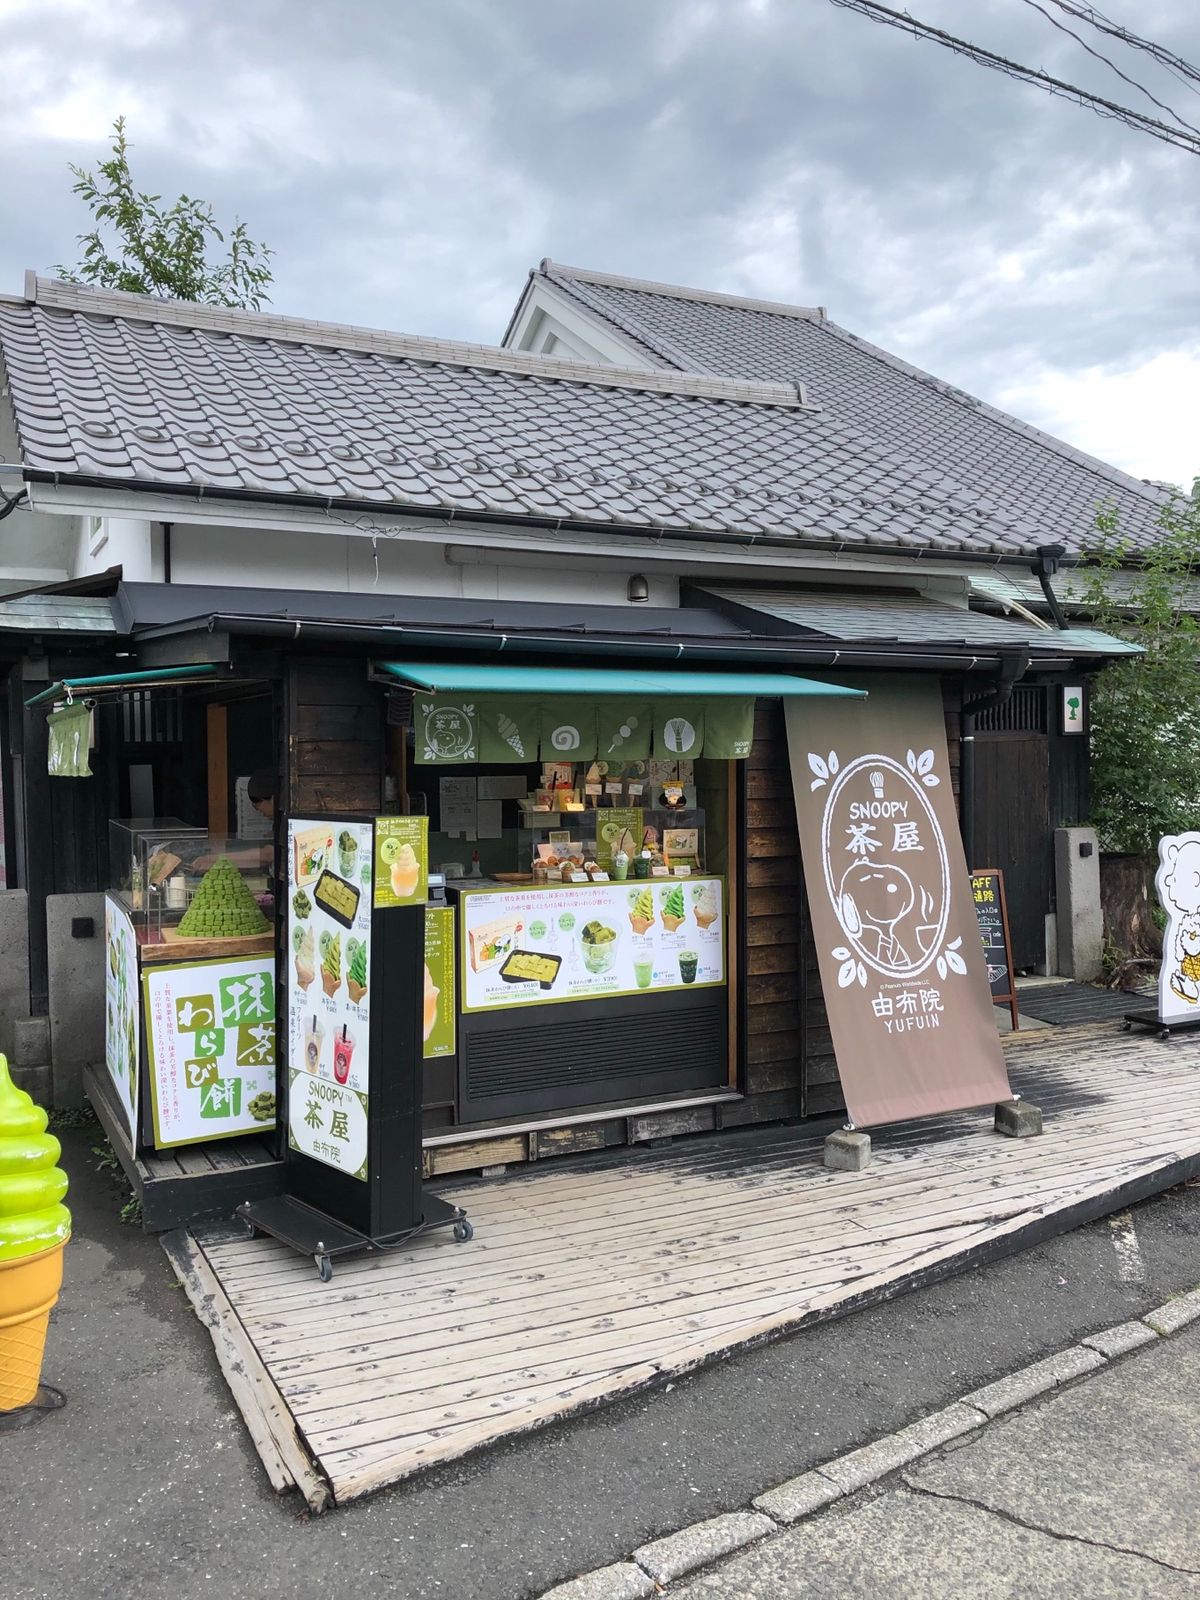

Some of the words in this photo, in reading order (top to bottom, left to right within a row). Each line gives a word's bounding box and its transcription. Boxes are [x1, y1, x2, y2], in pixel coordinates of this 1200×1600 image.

[435, 720, 461, 729] 茶屋
[849, 801, 909, 820] SNOOPY
[845, 821, 925, 855] 茶屋
[972, 876, 992, 889] AFF
[872, 988, 944, 1017] 由布院
[222, 973, 275, 1063] 抹茶
[884, 1013, 940, 1033] YUFUIN
[178, 1001, 236, 1117] わらび餅
[308, 1081, 344, 1107] SNOOPY
[304, 1100, 350, 1143] 茶屋
[313, 1139, 341, 1163] 由布院
